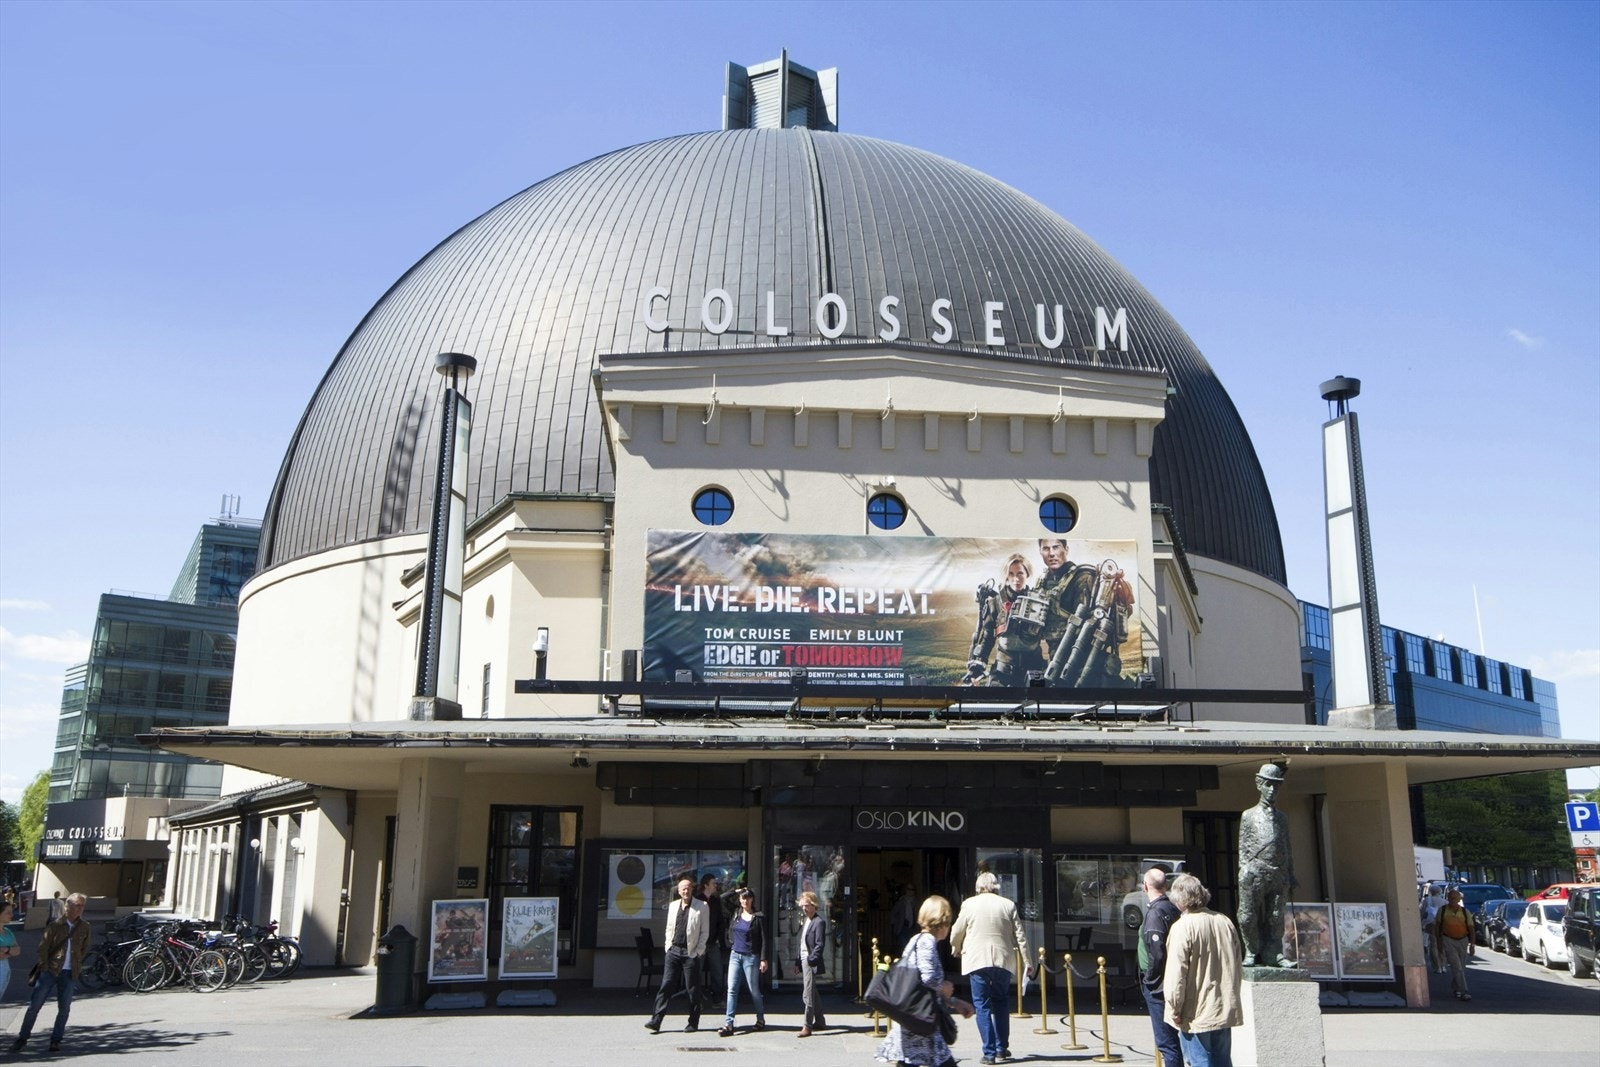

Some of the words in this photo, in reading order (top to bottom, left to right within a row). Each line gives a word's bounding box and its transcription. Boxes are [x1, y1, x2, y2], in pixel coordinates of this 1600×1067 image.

[643, 286, 1128, 352] COLOSSEUM
[674, 584, 747, 612] LIVE.
[755, 585, 810, 613] DIE.
[817, 586, 936, 615] REPEAT.
[704, 628, 734, 639] TOM
[739, 628, 791, 640] CRUISE
[810, 629, 852, 641] EMILY
[857, 630, 904, 641] BLUNT
[704, 644, 757, 665] EDGE
[760, 649, 781, 666] OF
[781, 645, 903, 667] TOMORROW
[1573, 806, 1591, 829] P
[69, 826, 127, 839] COLOSSEUM
[46, 844, 74, 856] BILLETTER
[512, 905, 532, 917] KULE
